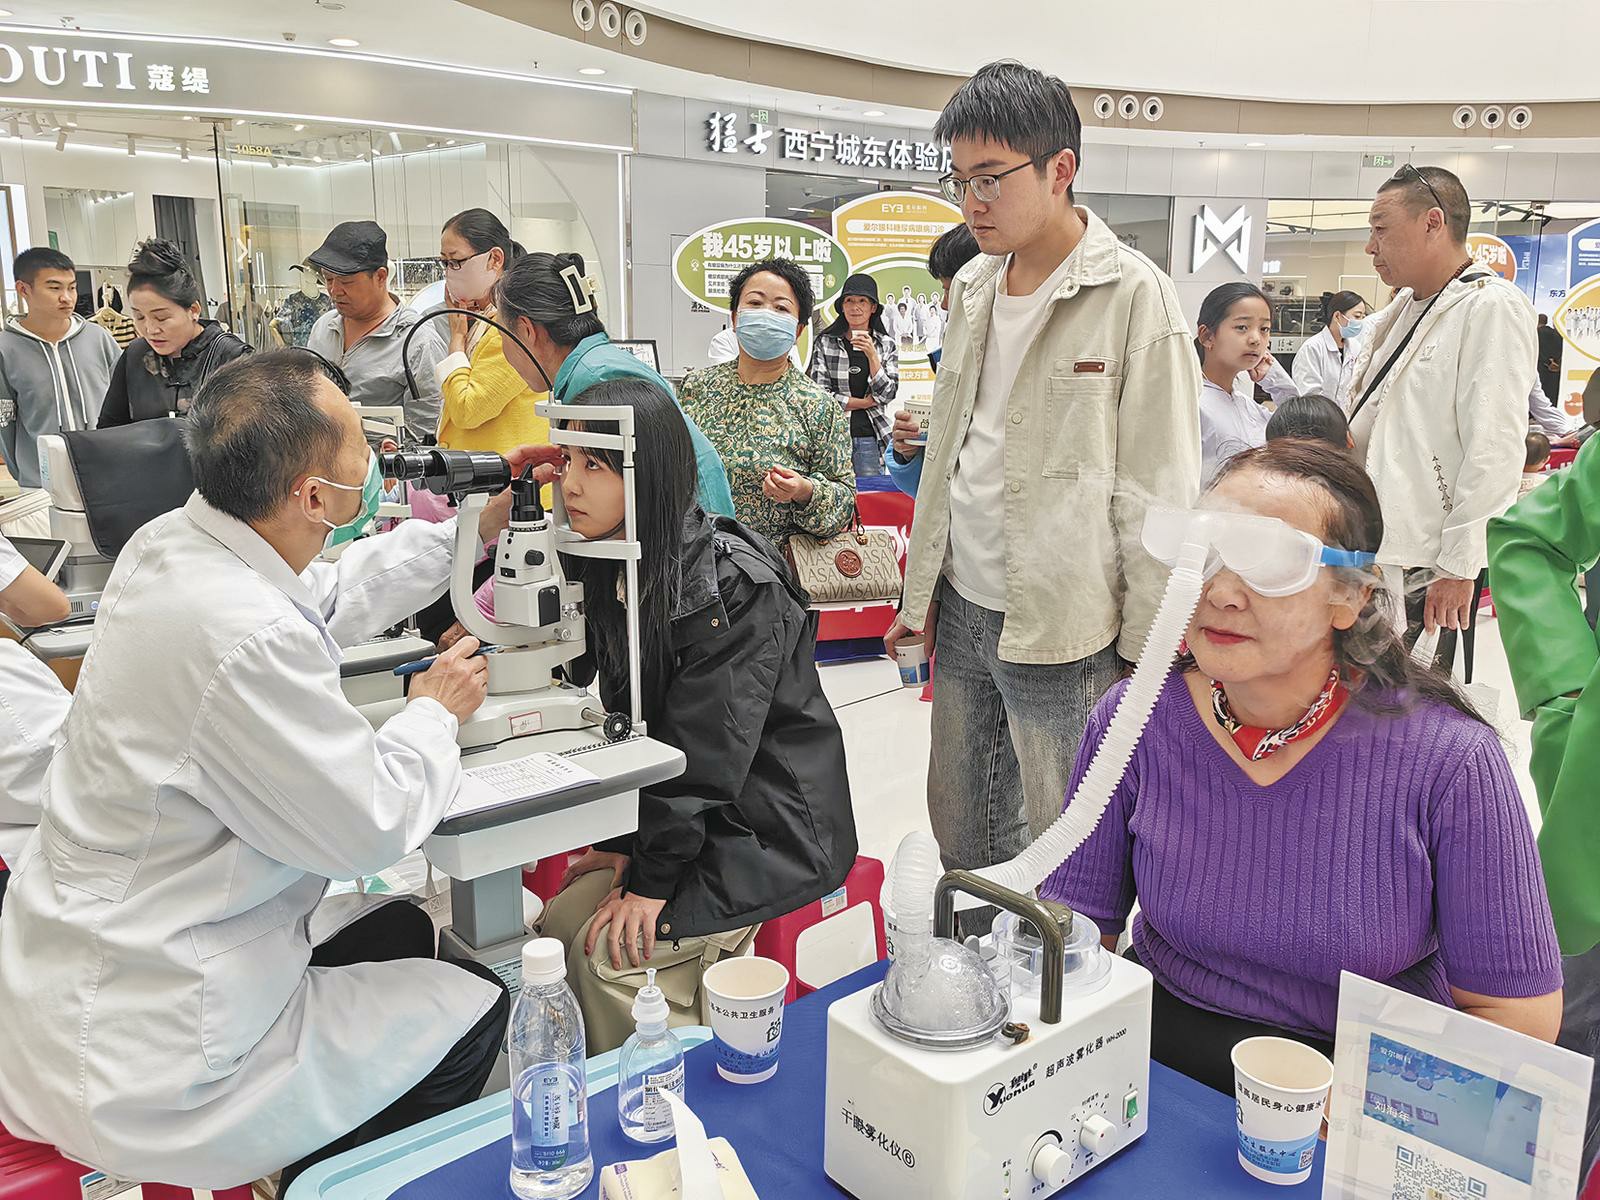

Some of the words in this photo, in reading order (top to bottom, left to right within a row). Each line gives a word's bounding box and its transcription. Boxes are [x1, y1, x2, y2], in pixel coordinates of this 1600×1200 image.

[146, 63, 210, 94] 蔻缇
[235, 144, 272, 156] 1058A
[702, 231, 832, 263] 我45岁以上啦
[1045, 1036, 1104, 1079] 超声波雾化器
